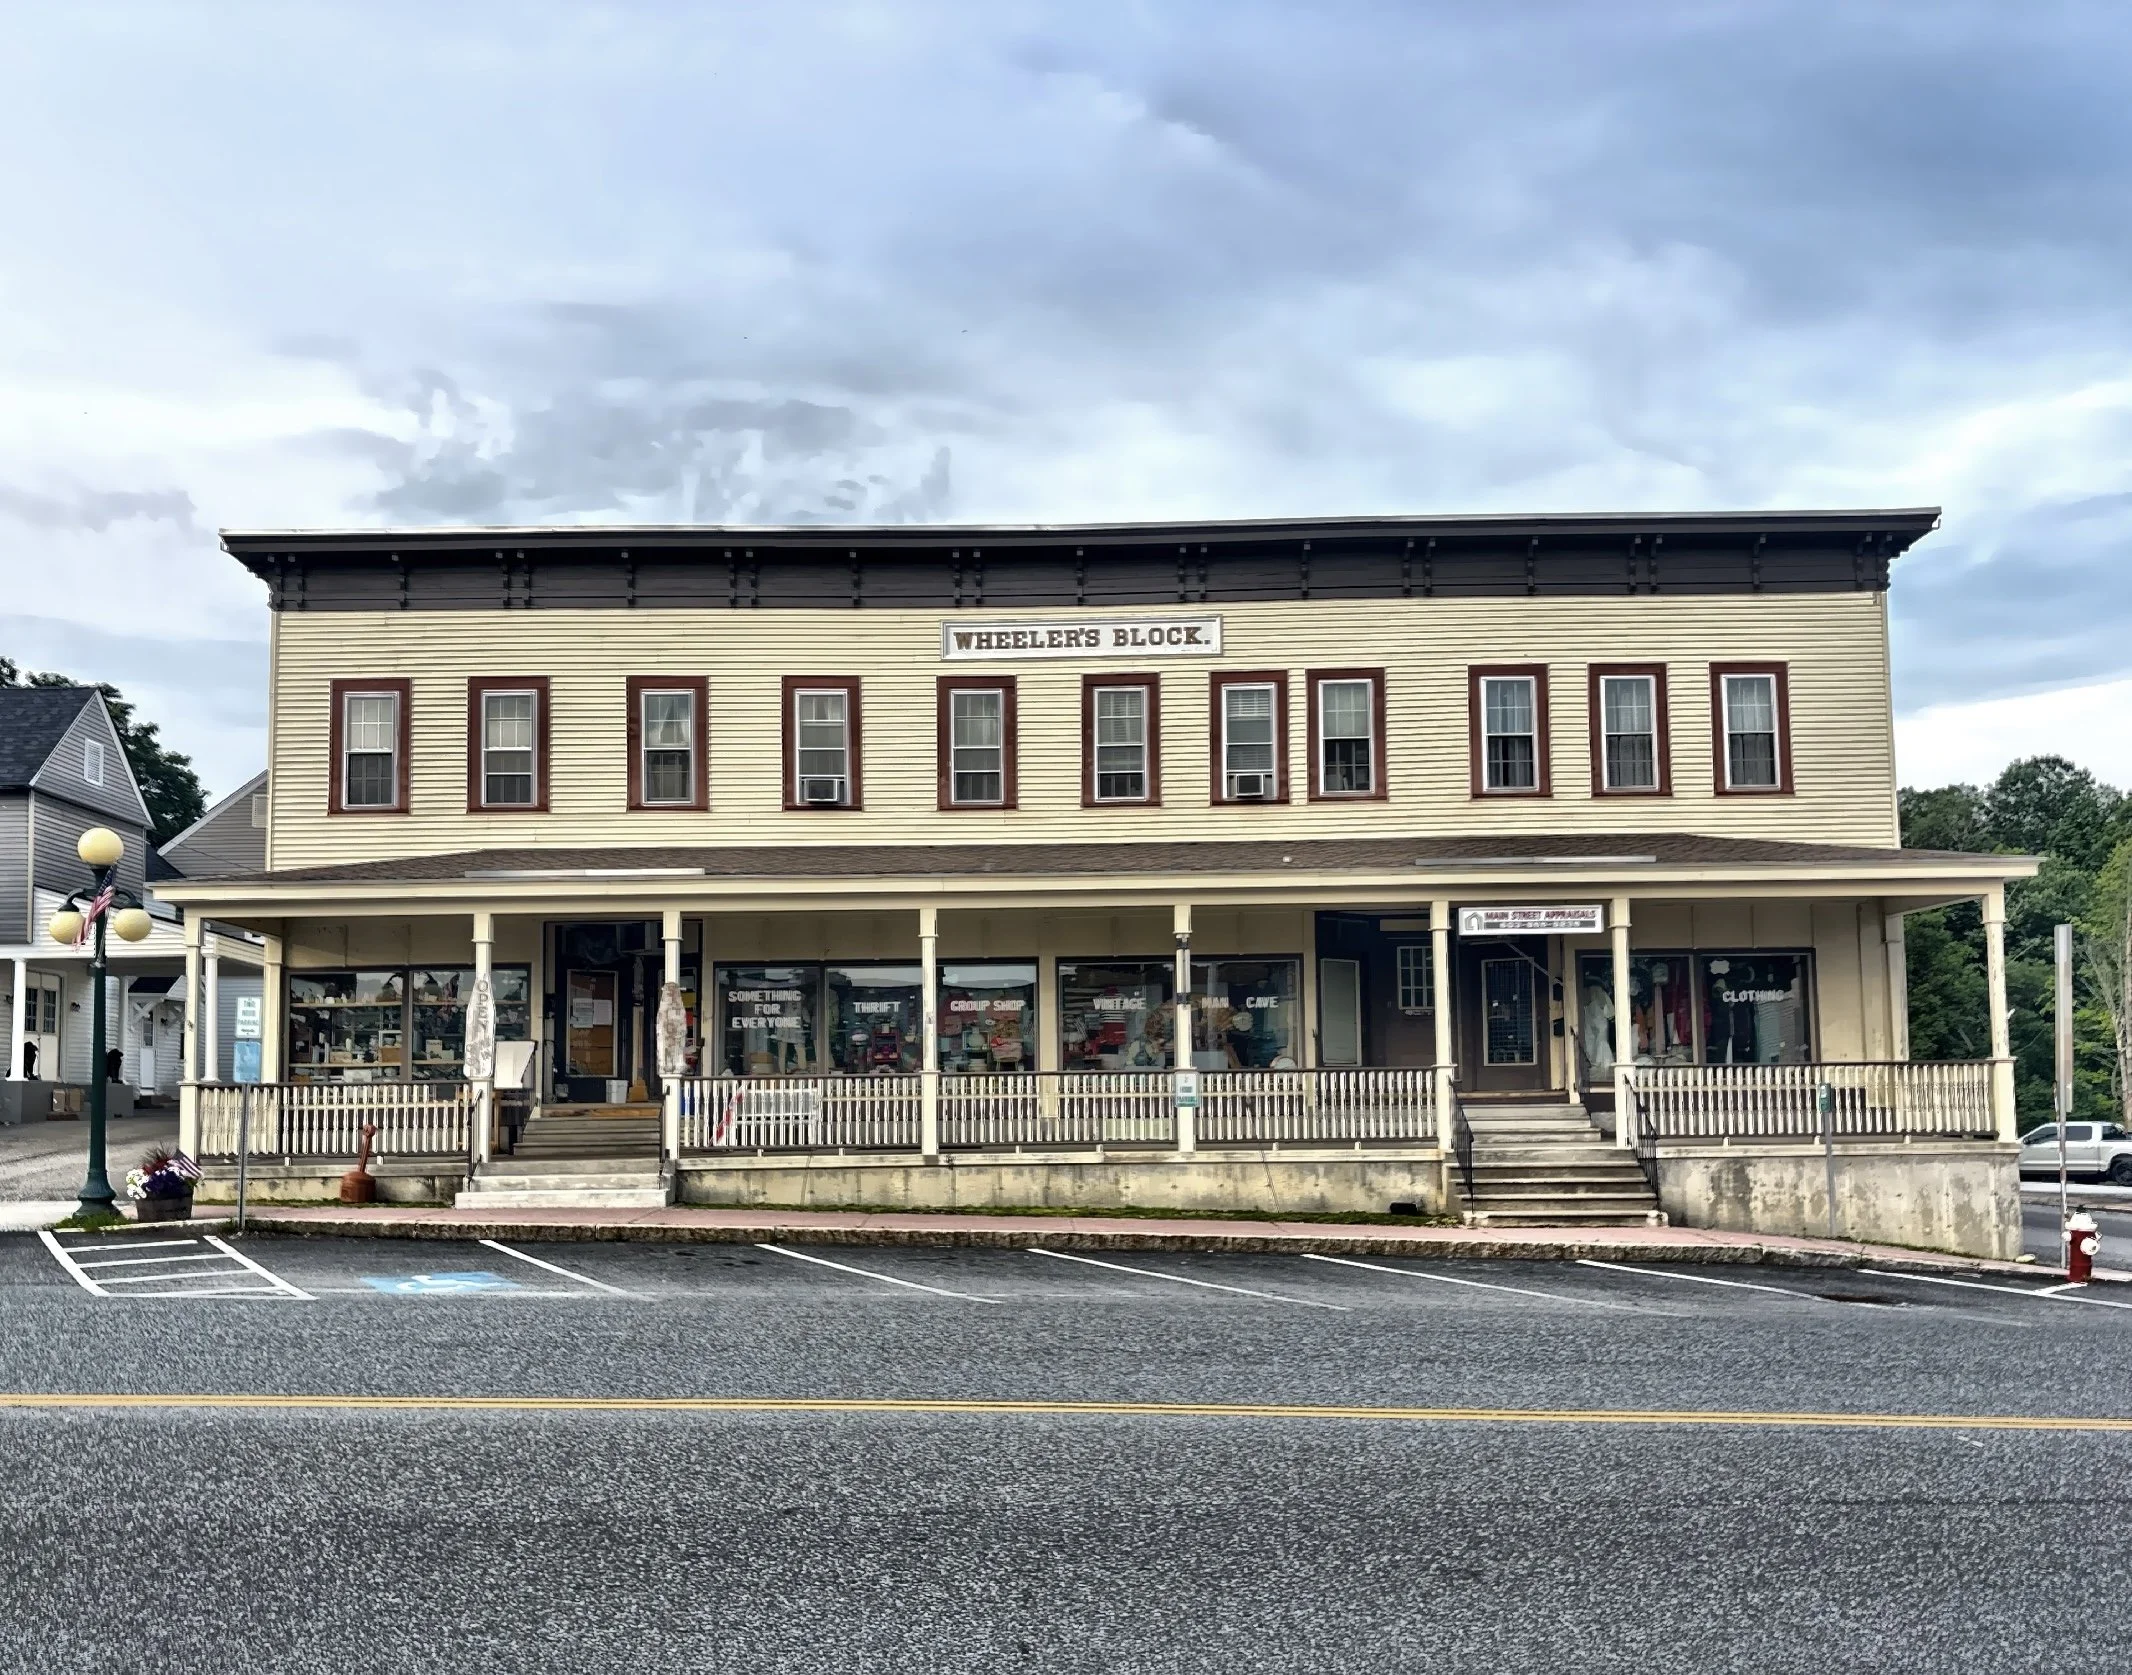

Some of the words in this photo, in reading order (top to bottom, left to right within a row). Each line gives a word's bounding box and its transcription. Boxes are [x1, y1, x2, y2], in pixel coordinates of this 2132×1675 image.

[953, 628, 1101, 650] WHEELER'S
[1113, 626, 1212, 648] BLOCK.
[1484, 911, 1509, 920] MAIN
[1511, 911, 1542, 920] STREET
[1544, 910, 1596, 919] APPRAISALS
[728, 990, 801, 1002] SOMETHING
[1722, 990, 1784, 1002] CLOTHING
[754, 1003, 781, 1015] FOR
[852, 1001, 901, 1013] THRIFT
[950, 1000, 990, 1011] GROUP
[993, 1000, 1026, 1011] SHOP
[1093, 998, 1147, 1010] VINTAGE
[1201, 997, 1230, 1008] MAN
[1246, 996, 1279, 1008] CAVE
[731, 1016, 801, 1028] EVERYONE
